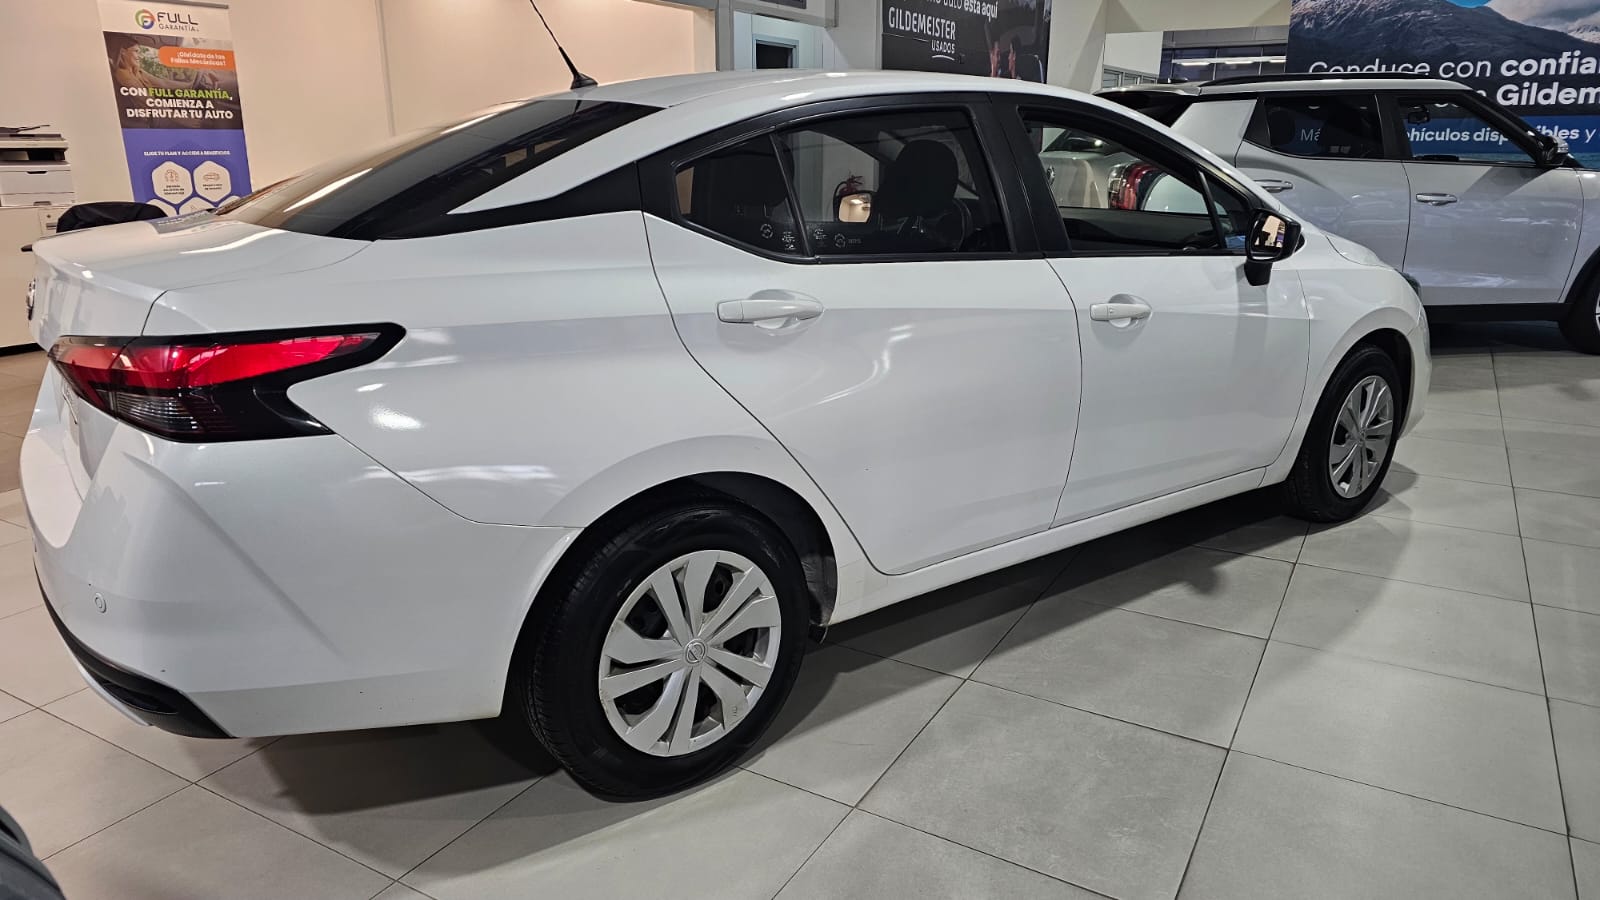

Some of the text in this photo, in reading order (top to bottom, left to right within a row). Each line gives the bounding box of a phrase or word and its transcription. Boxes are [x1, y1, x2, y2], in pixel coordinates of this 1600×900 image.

[157, 12, 199, 25] FULL
[888, 6, 956, 40] GILDEMEISTER
[158, 23, 196, 32] GARANTÍA
[931, 40, 955, 54] USADOS
[1438, 60, 1492, 78] con
[1500, 50, 1600, 77] confia
[120, 86, 233, 100] CON FULL GARANTÍA,
[1496, 82, 1600, 106] Gildem
[146, 98, 215, 109] COMIENZA A
[126, 108, 234, 119] DISFRUTAR TU AUTO
[1585, 128, 1597, 143] y
